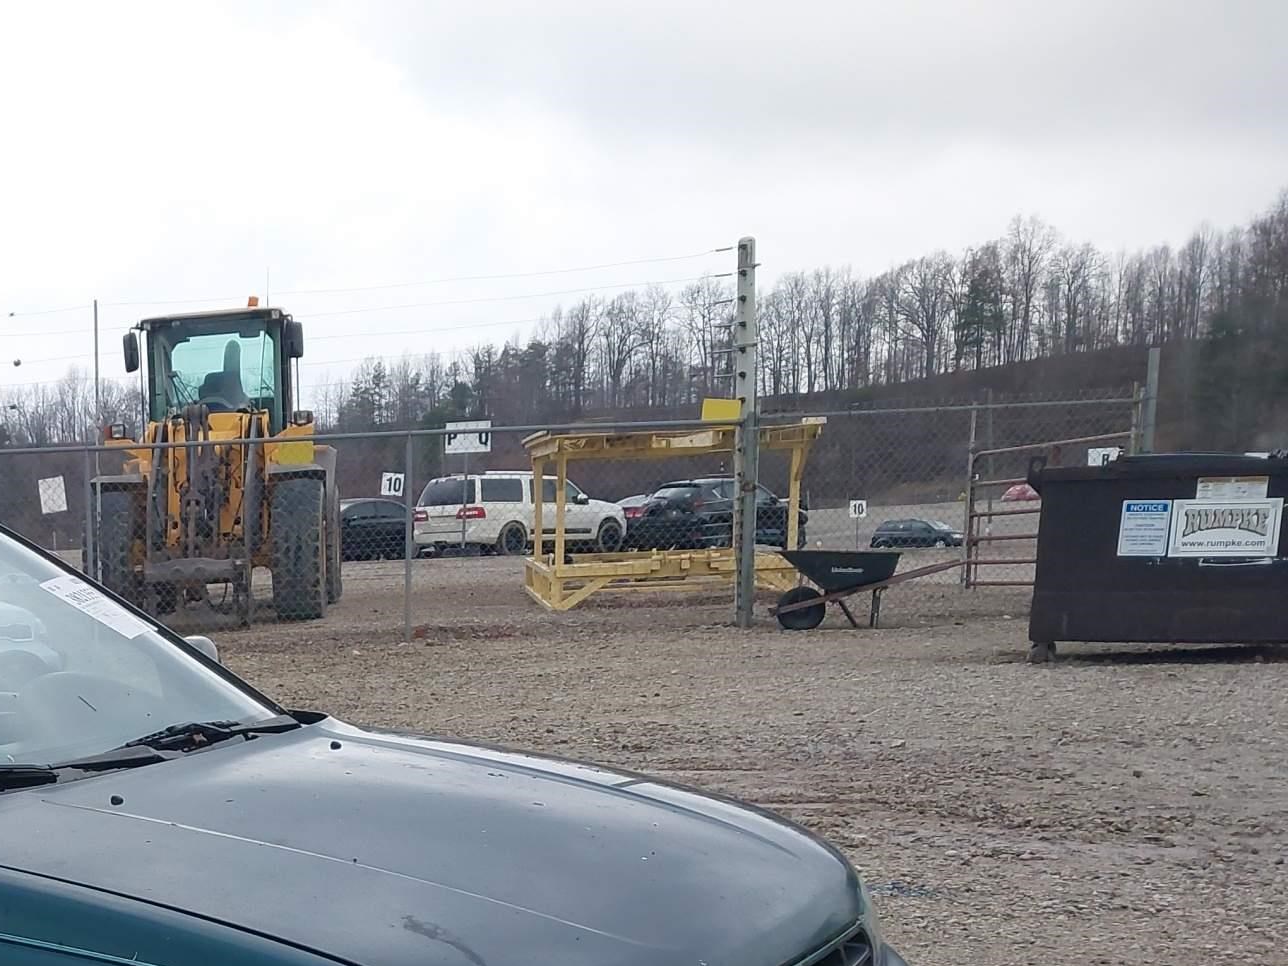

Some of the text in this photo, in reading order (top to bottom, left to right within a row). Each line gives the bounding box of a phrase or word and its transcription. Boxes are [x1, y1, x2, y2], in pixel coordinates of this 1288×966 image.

[447, 432, 489, 446] P Q
[386, 477, 401, 492] 10
[853, 503, 864, 515] 10
[1130, 504, 1164, 512] NOTICE
[1181, 507, 1271, 537] RUMPKE
[1181, 539, 1266, 548] www.rumpke.com
